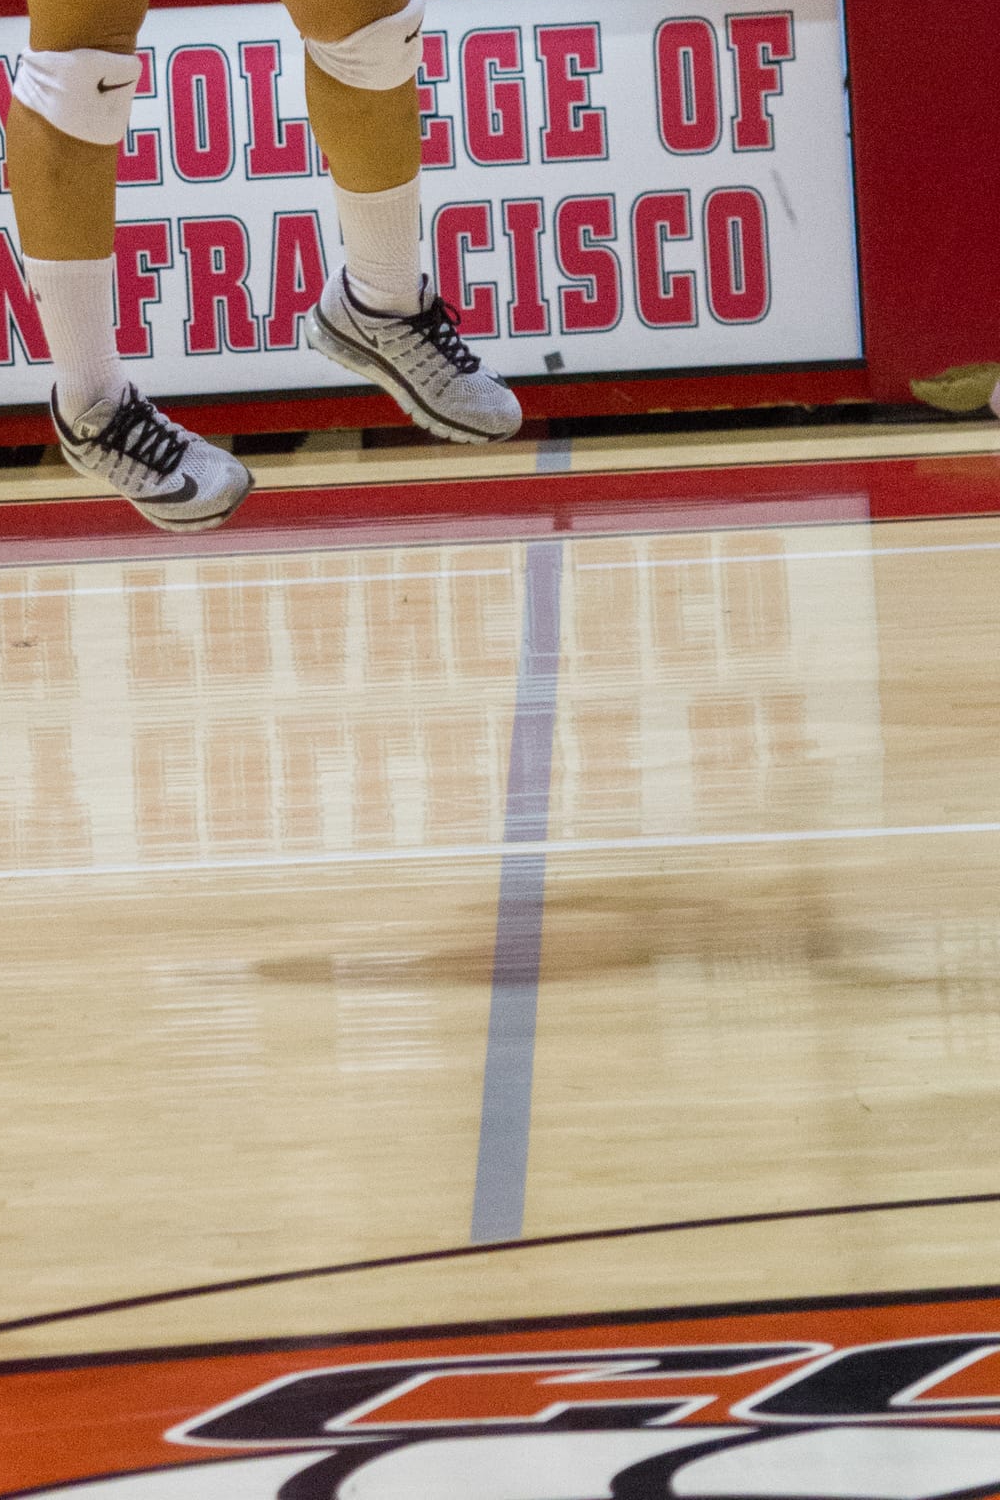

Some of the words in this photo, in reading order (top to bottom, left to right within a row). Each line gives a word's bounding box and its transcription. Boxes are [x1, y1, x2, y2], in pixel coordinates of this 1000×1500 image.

[114, 21, 609, 188] OLEGE
[653, 9, 796, 157] OF
[112, 184, 772, 361] FRACISCO
